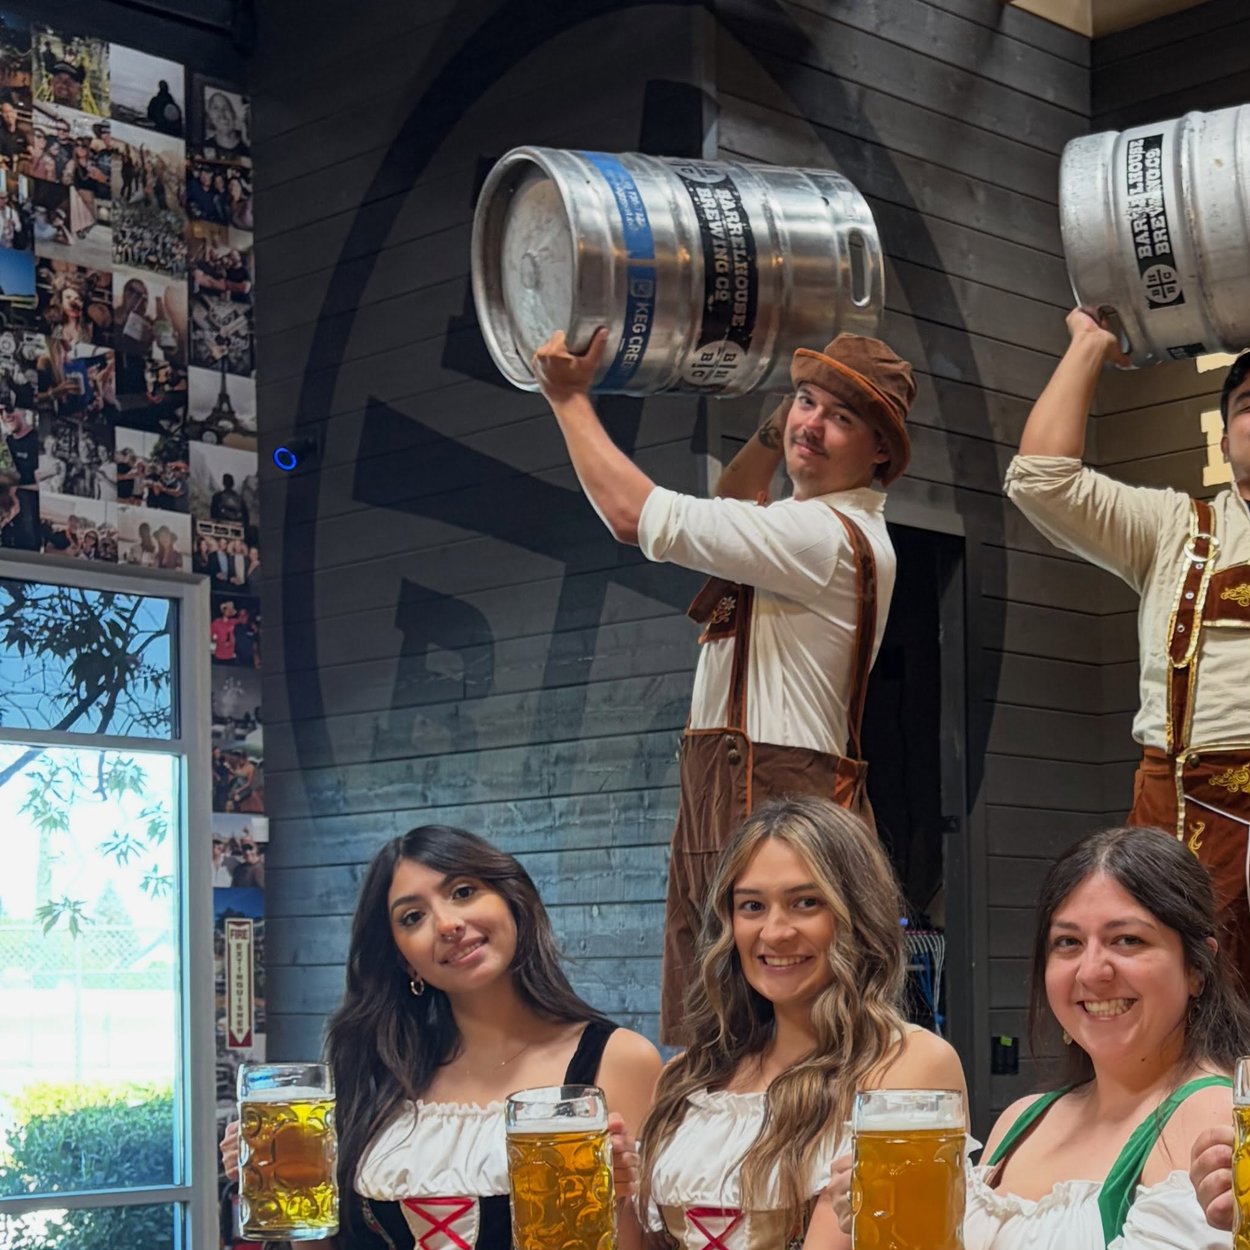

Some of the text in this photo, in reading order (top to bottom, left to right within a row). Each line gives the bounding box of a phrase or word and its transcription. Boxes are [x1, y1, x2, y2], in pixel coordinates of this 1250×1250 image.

[696, 187, 730, 274] BREWING
[714, 187, 749, 328] BARRELHOUSE
[619, 302, 649, 370] KEG CRED
[229, 929, 249, 940] FIRE
